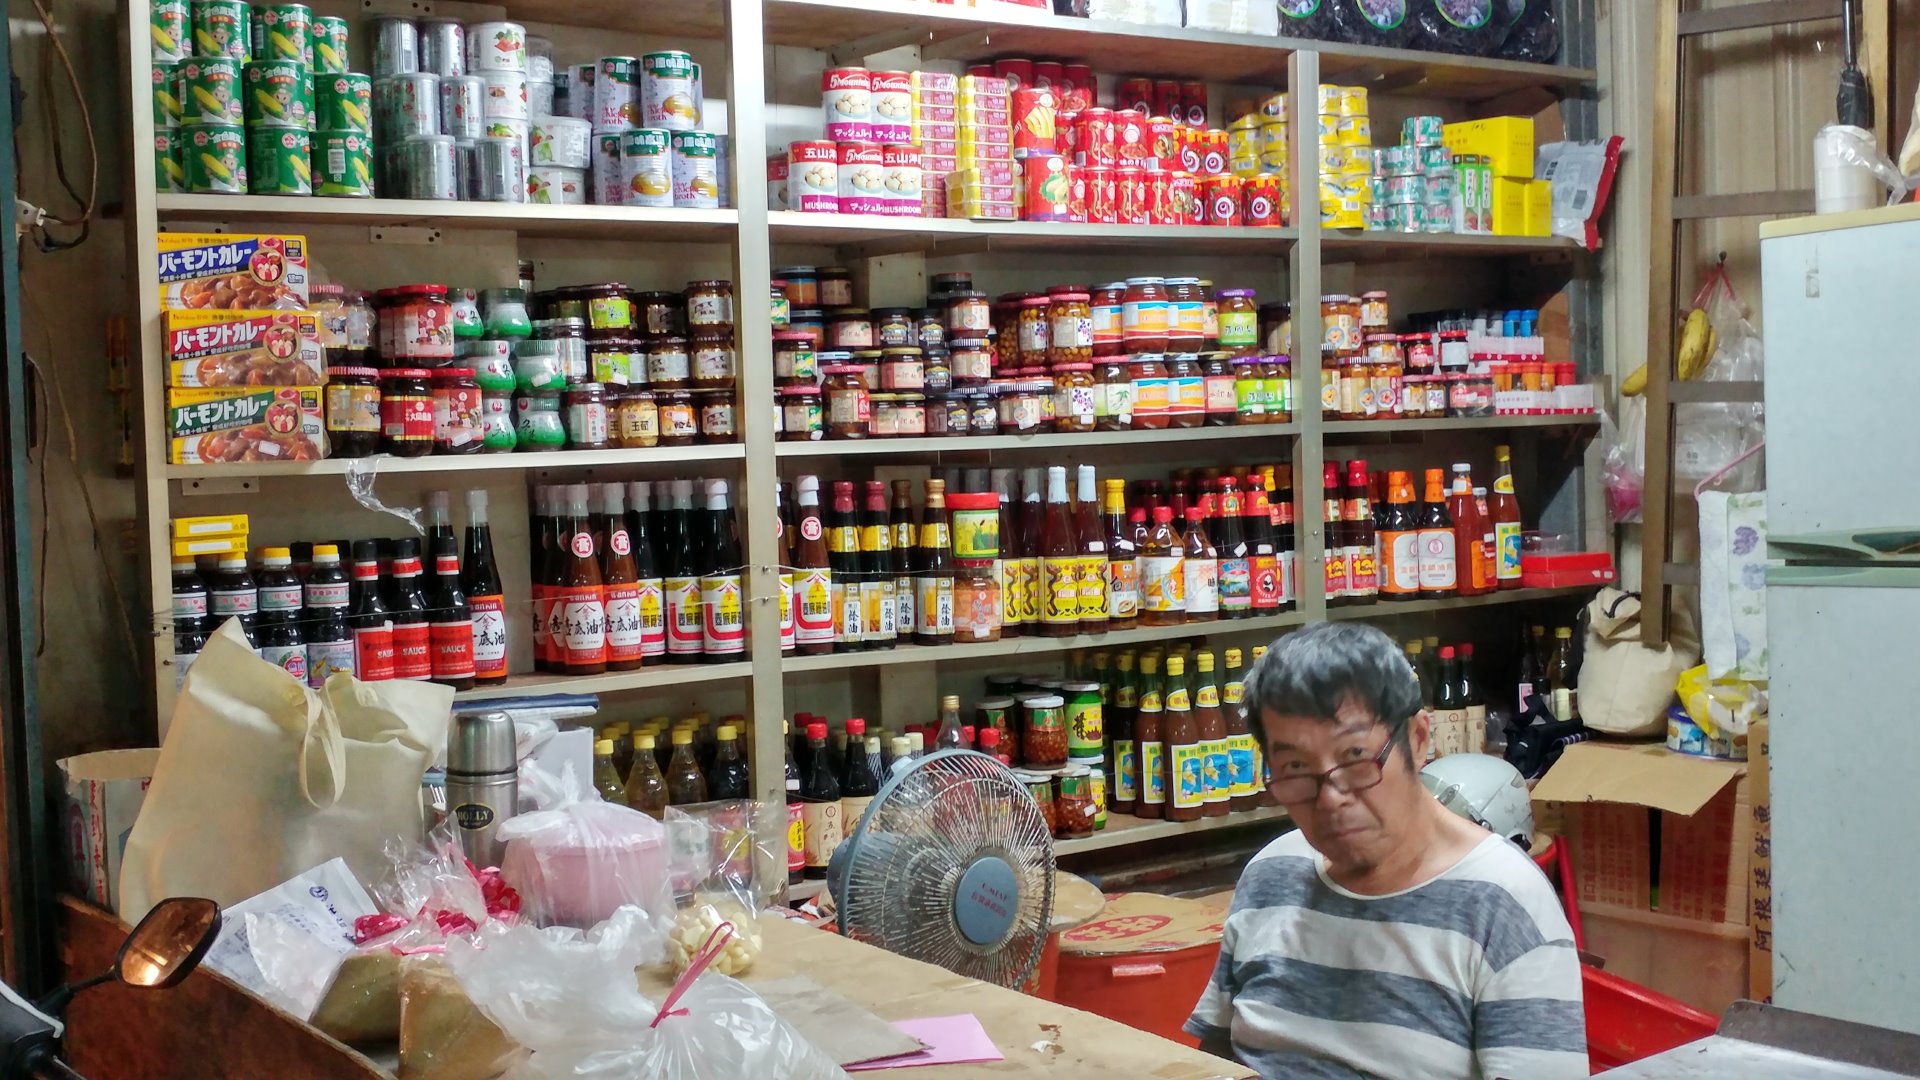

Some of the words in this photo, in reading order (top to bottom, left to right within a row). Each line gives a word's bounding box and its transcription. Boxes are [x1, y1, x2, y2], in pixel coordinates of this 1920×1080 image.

[160, 244, 252, 274] バーモントカレー
[174, 321, 266, 351] バーモントカレー
[175, 397, 268, 428] バーモントカレー
[402, 646, 426, 656] SAUCE
[441, 644, 466, 654] SAUCE
